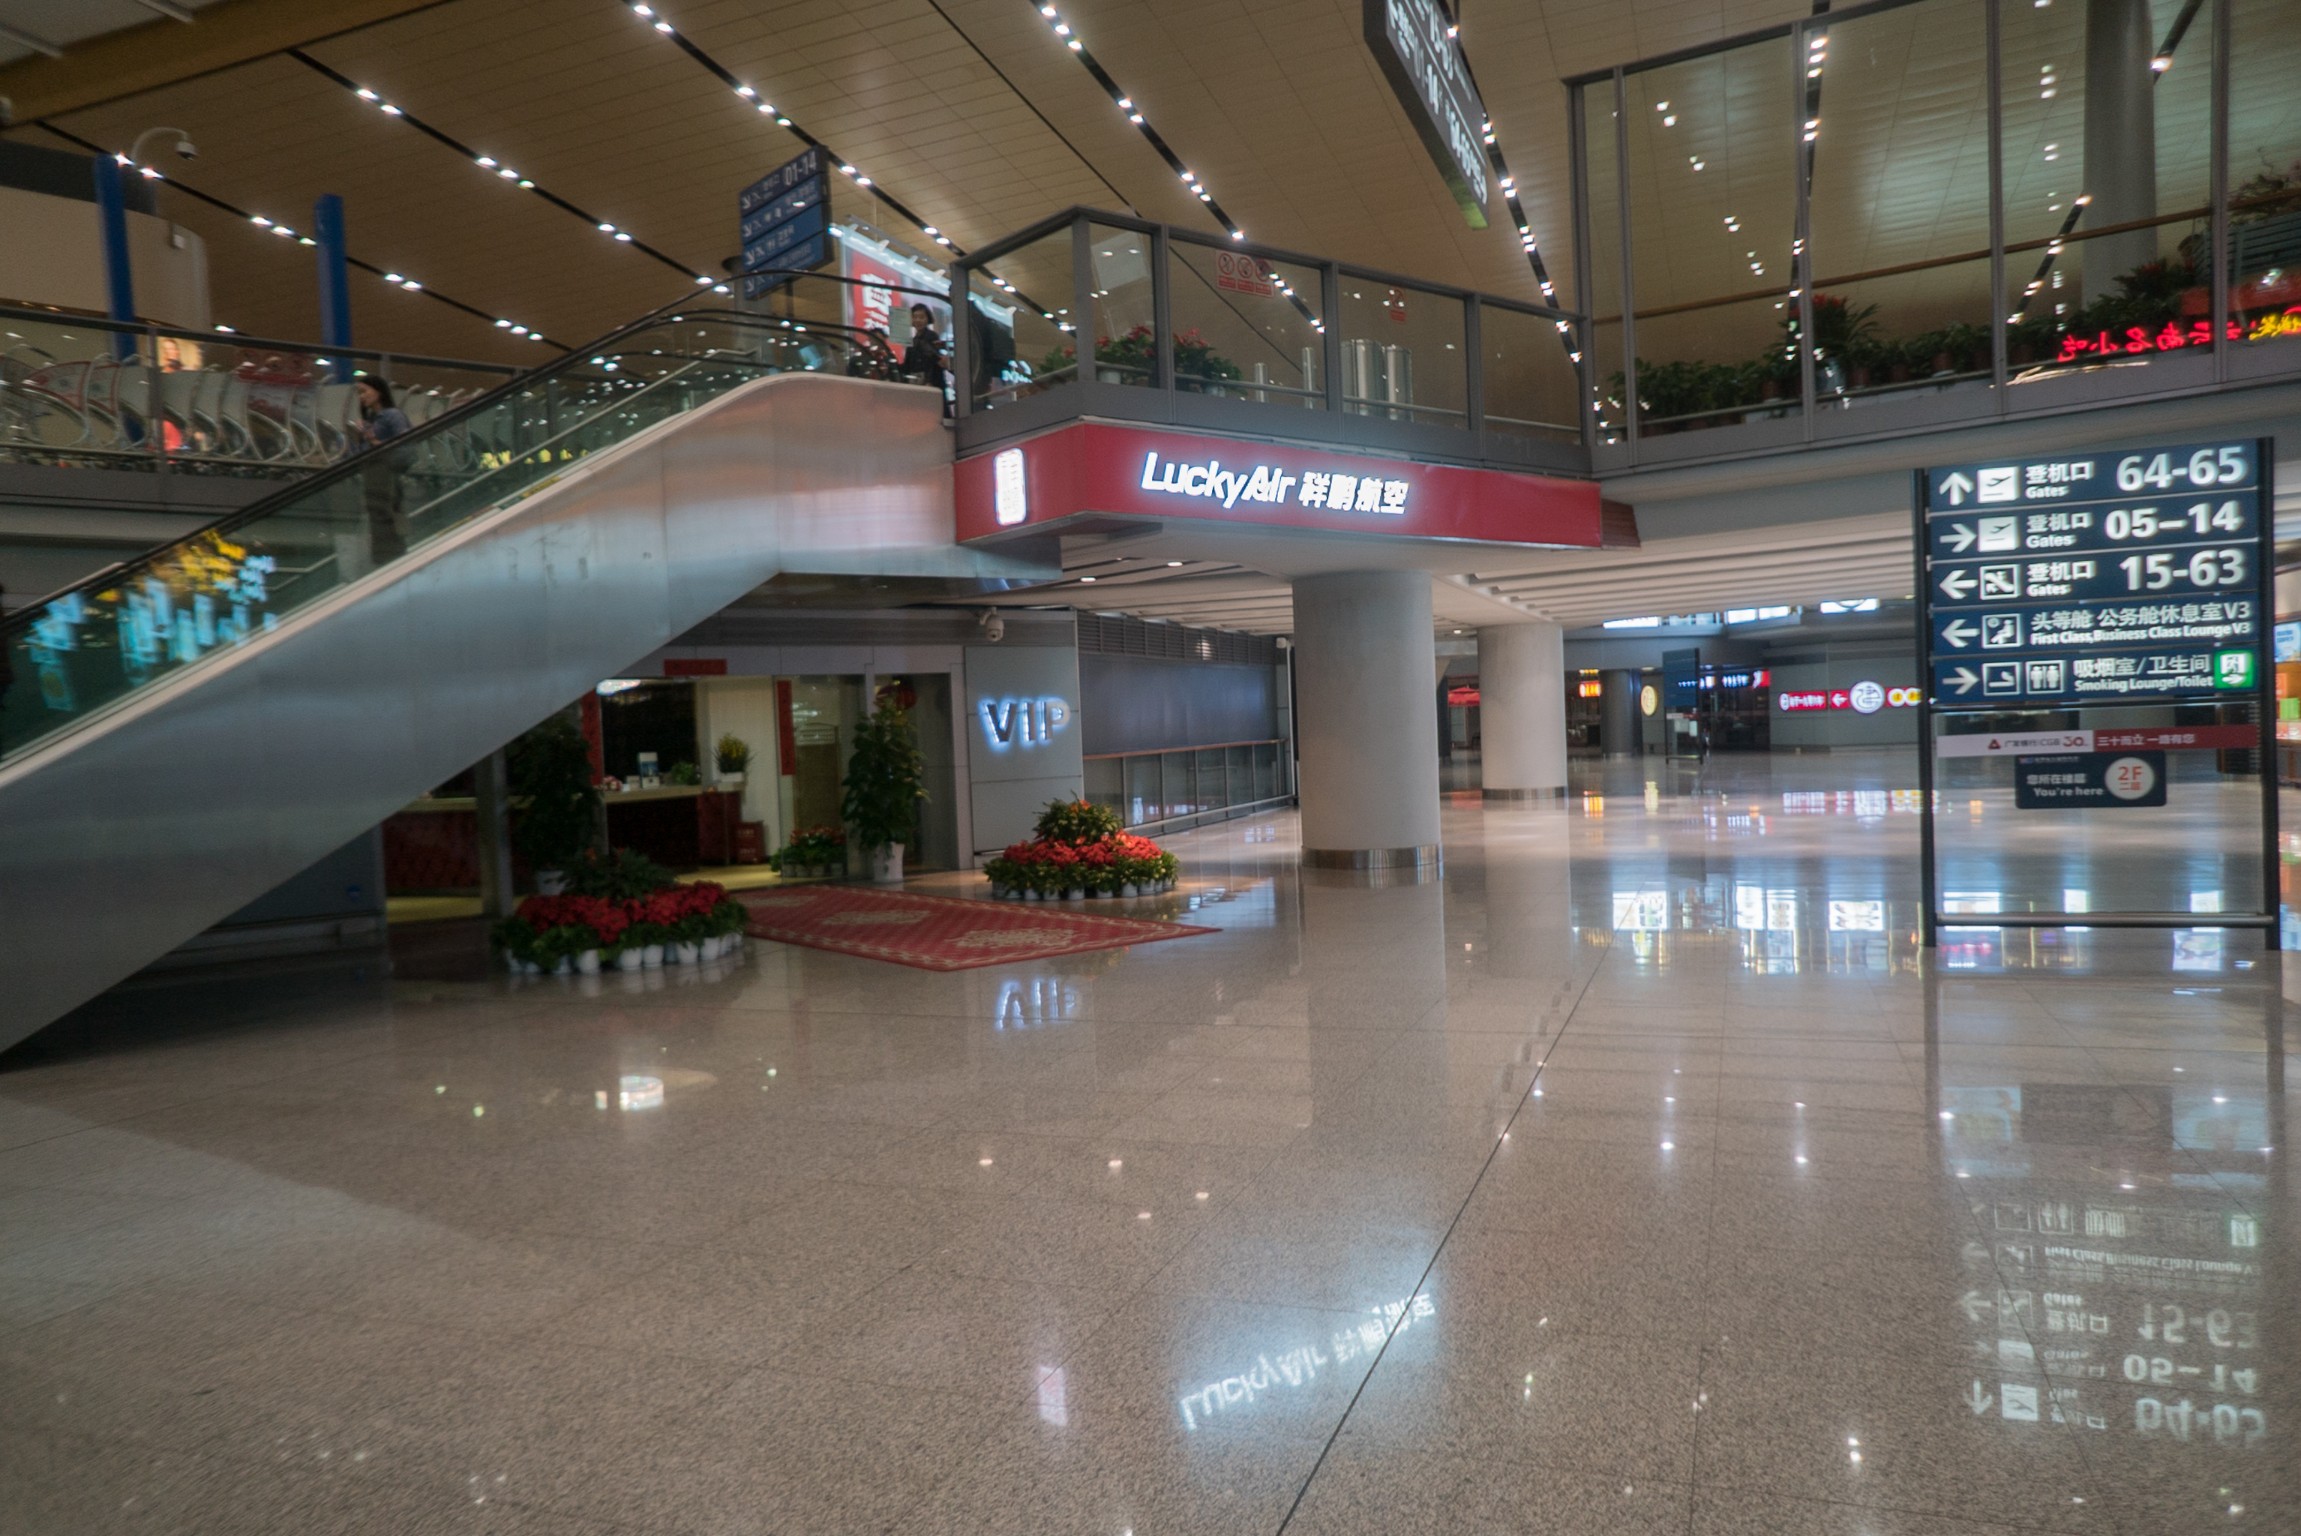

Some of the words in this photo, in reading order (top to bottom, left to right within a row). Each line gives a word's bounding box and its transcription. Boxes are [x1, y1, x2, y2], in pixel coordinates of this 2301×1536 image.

[1141, 452, 1296, 508] LuckyAir
[2025, 461, 2095, 486] 登机口
[2117, 447, 2248, 491] 64-65
[1299, 471, 1409, 514] 祥鹏航空
[2025, 486, 2069, 498] Gates
[2027, 511, 2093, 533] 登机口
[2026, 534, 2076, 548] Gates
[2028, 560, 2095, 582] 登机口
[2120, 549, 2246, 591] 15-63
[2027, 583, 2071, 597] Gates
[2031, 611, 2093, 632] 头等舱
[2030, 632, 2058, 645] First
[2149, 626, 2182, 639] Class
[2184, 624, 2231, 638] Lounge
[2232, 622, 2250, 634] V3
[2074, 679, 2128, 693] Smoking
[979, 697, 1071, 746] VIP
[2117, 765, 2144, 781] 2F
[2033, 787, 2073, 797] You're
[2075, 786, 2104, 796] here
